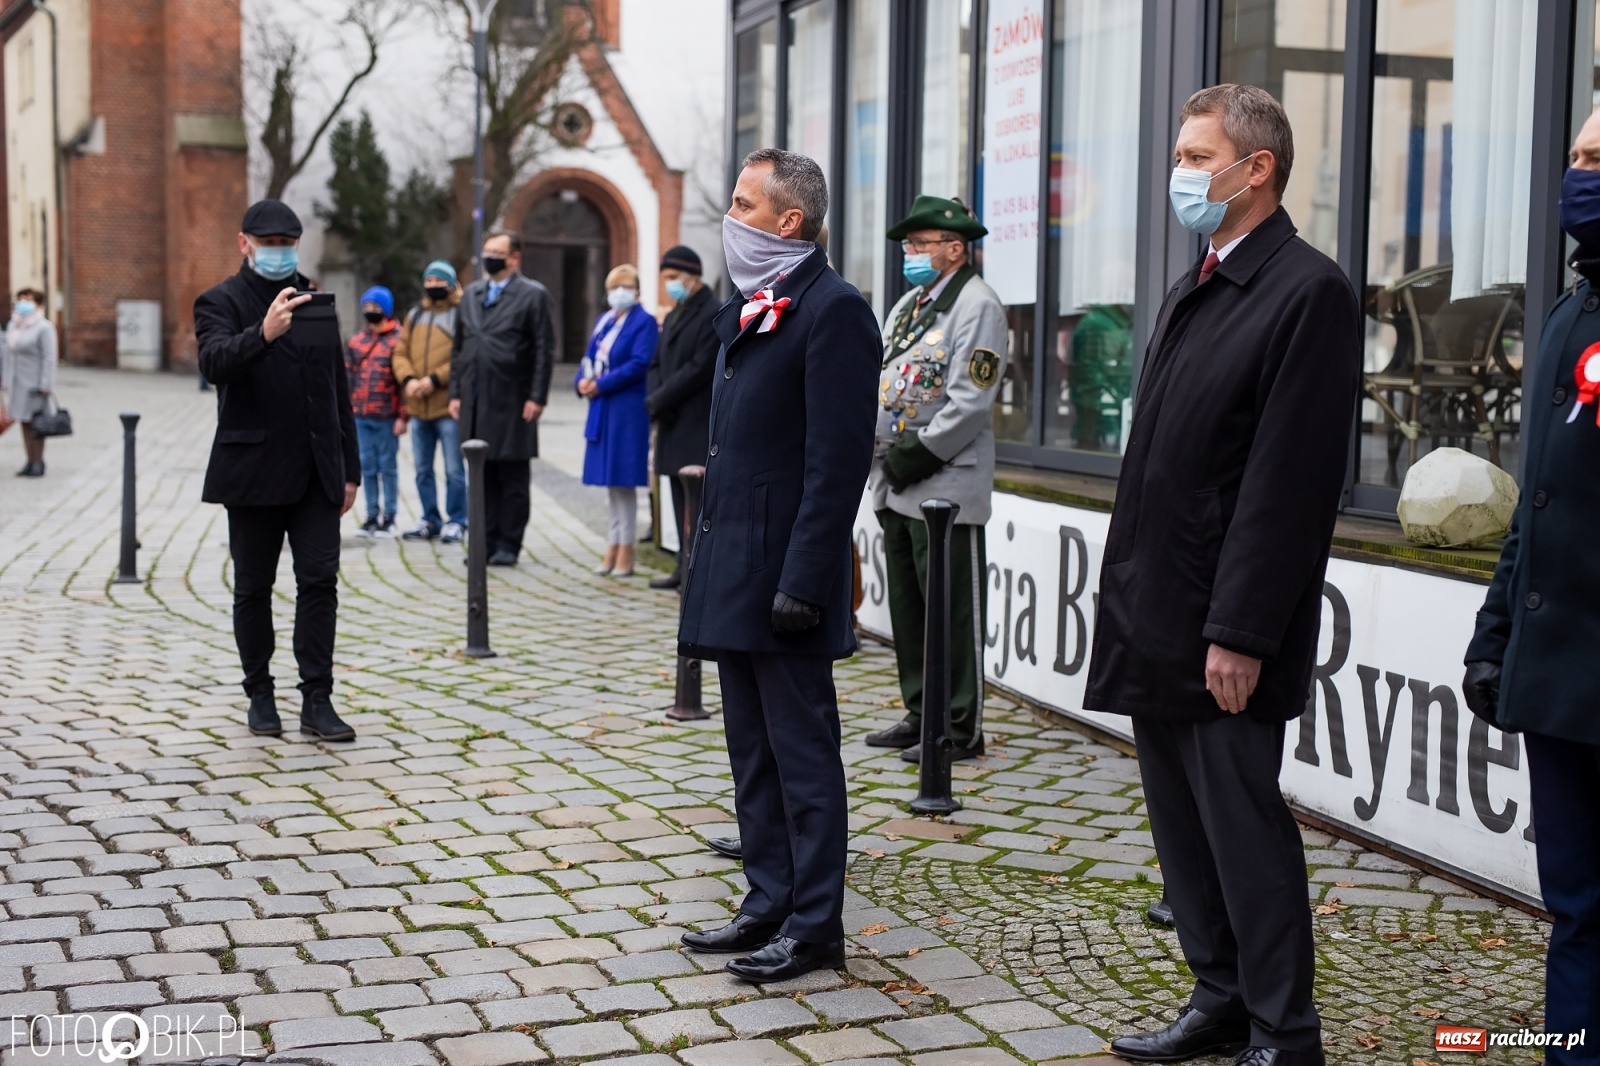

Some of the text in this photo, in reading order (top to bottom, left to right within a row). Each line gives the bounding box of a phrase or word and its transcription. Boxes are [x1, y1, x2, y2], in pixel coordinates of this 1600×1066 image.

[993, 5, 1043, 54] ZAMÓW
[1007, 87, 1024, 108] LUB
[1053, 524, 1101, 676] B
[1295, 579, 1537, 844] Ryne
